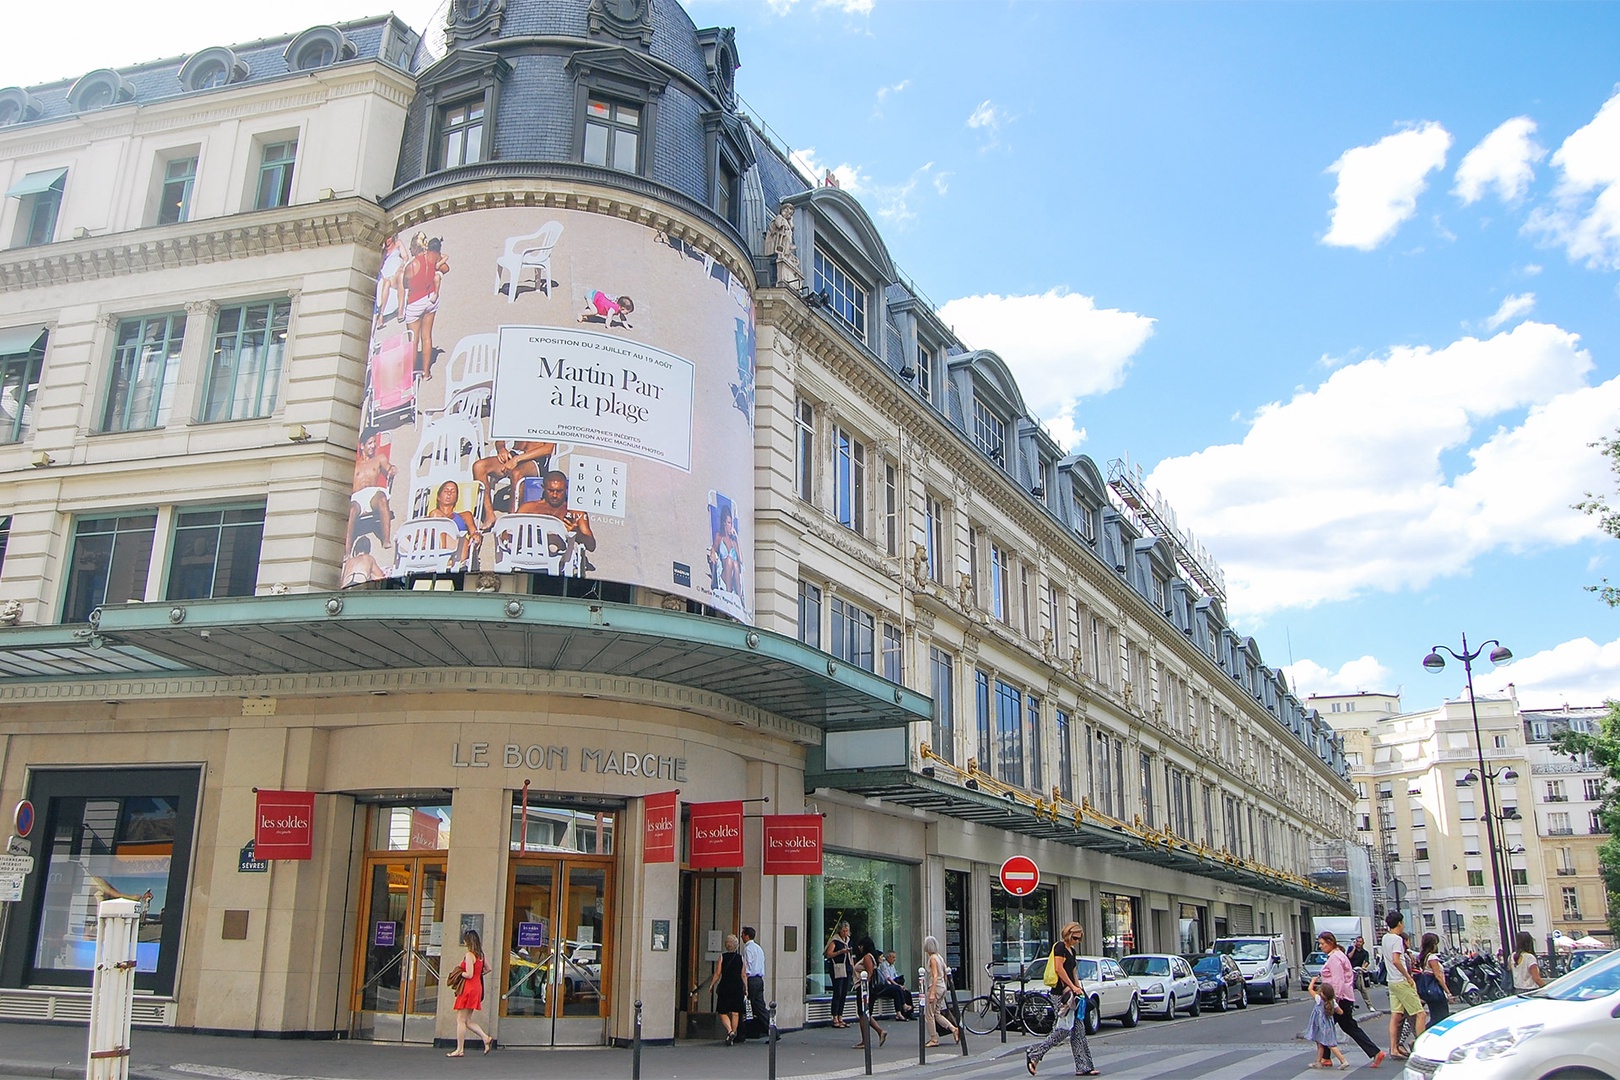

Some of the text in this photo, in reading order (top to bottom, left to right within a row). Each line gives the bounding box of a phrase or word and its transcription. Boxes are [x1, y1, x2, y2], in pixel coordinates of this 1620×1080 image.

[528, 336, 580, 346] EXPOSITION
[601, 346, 632, 356] JUILLET
[632, 352, 644, 360] AU
[654, 359, 673, 370] AOÛT
[537, 356, 665, 401] Martin Parr
[550, 385, 650, 424] à la plage
[557, 424, 614, 436] PHOTOGRAPHIES
[538, 428, 595, 440] COLLABORATION
[614, 439, 640, 450] MAGNUM
[641, 446, 665, 456] PHOTOS
[566, 513, 625, 526] RIVE GAUCHE
[451, 742, 688, 782] LE BON MARCHE
[261, 814, 308, 829] les soldes
[647, 816, 673, 832] les soldes
[695, 824, 739, 839] les soldes
[769, 836, 817, 848] les soldes
